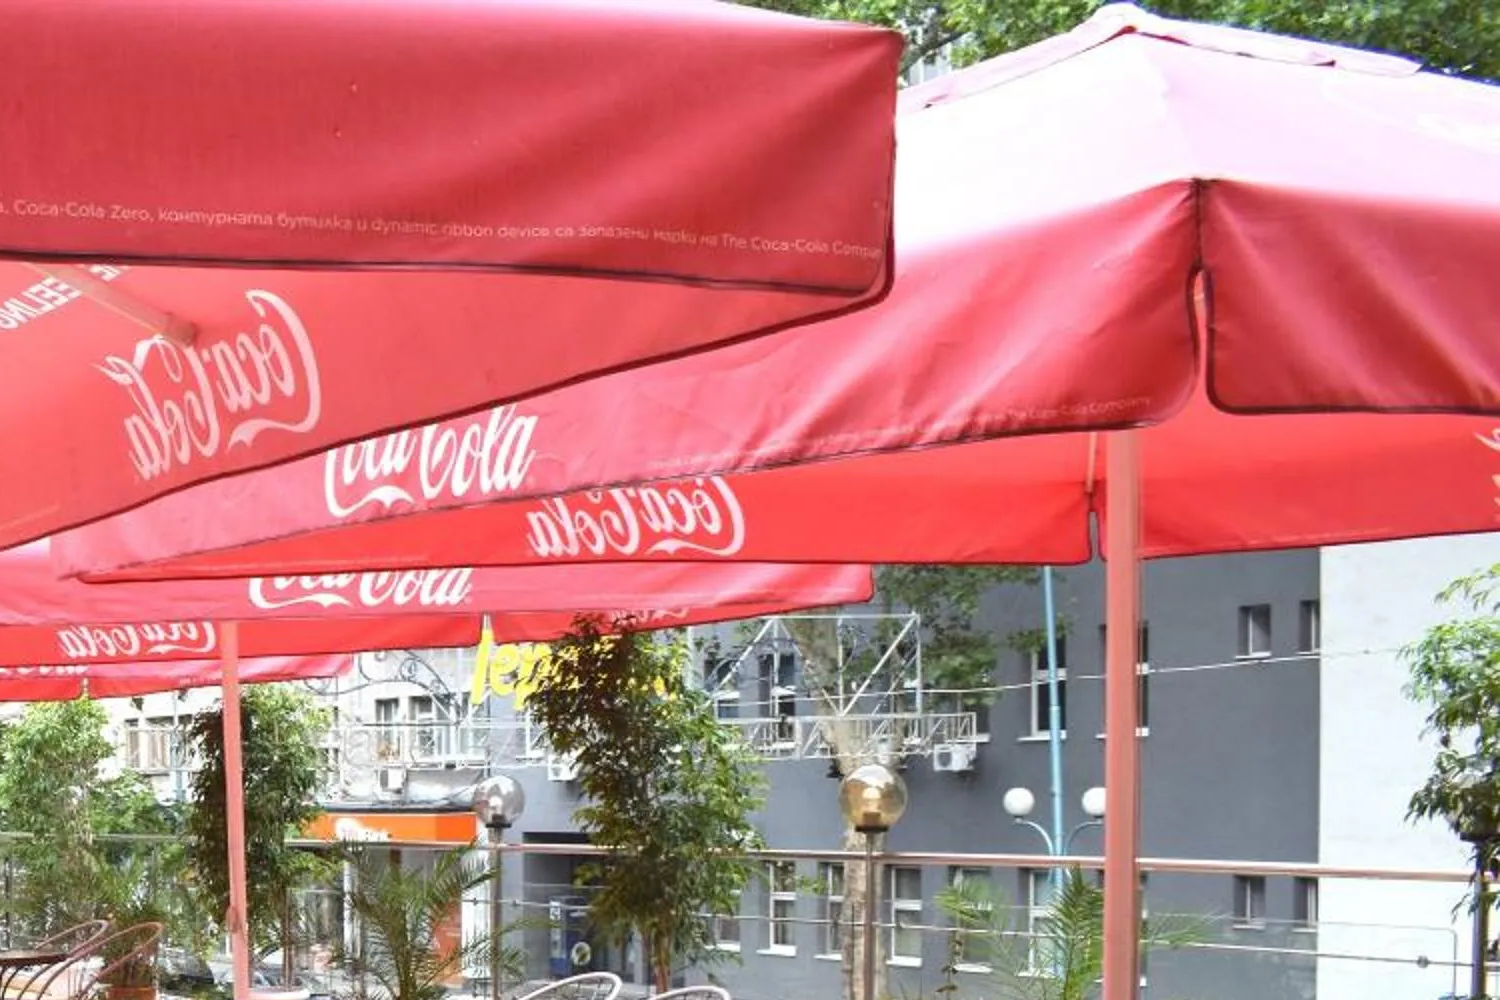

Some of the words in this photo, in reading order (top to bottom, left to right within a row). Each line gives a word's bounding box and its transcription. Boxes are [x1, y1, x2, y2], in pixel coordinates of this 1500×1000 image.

[13, 199, 105, 219] Coca-Cola
[722, 233, 747, 250] The
[751, 235, 830, 255] Coca-Cola
[325, 403, 539, 519] CocaCola
